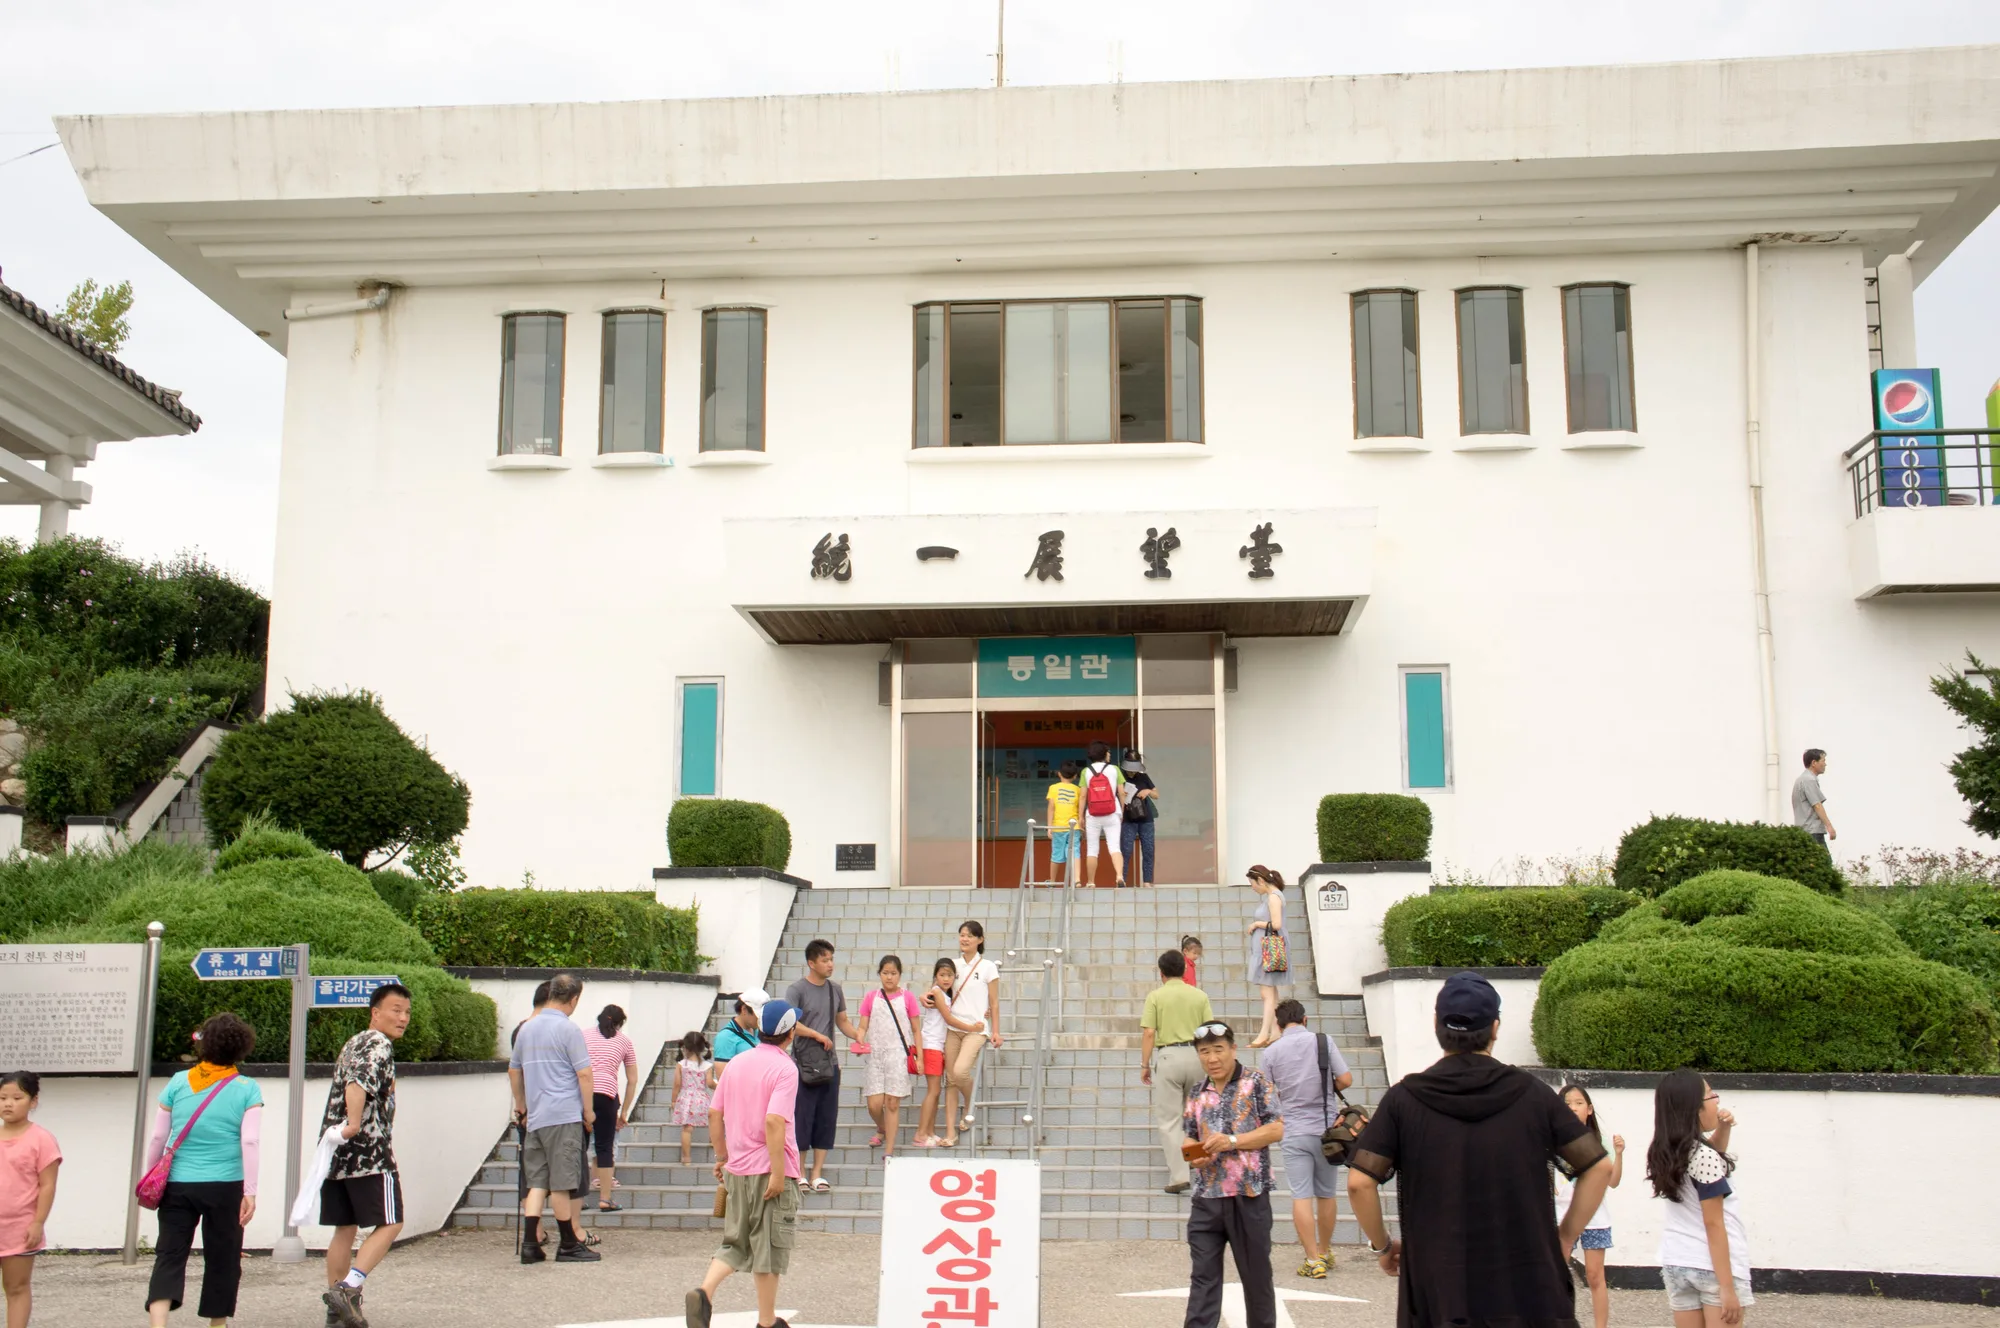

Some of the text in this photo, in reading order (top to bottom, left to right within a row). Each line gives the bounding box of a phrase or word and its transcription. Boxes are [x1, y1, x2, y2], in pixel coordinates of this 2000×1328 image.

[1900, 437, 1927, 509] peps
[1007, 654, 1111, 681] 통일관
[1324, 894, 1342, 902] 457
[24, 951, 47, 962] 전투
[52, 950, 86, 961] 전적비
[208, 953, 273, 968] 휴게실
[214, 969, 239, 977] Rest
[339, 996, 370, 1004] Ramp
